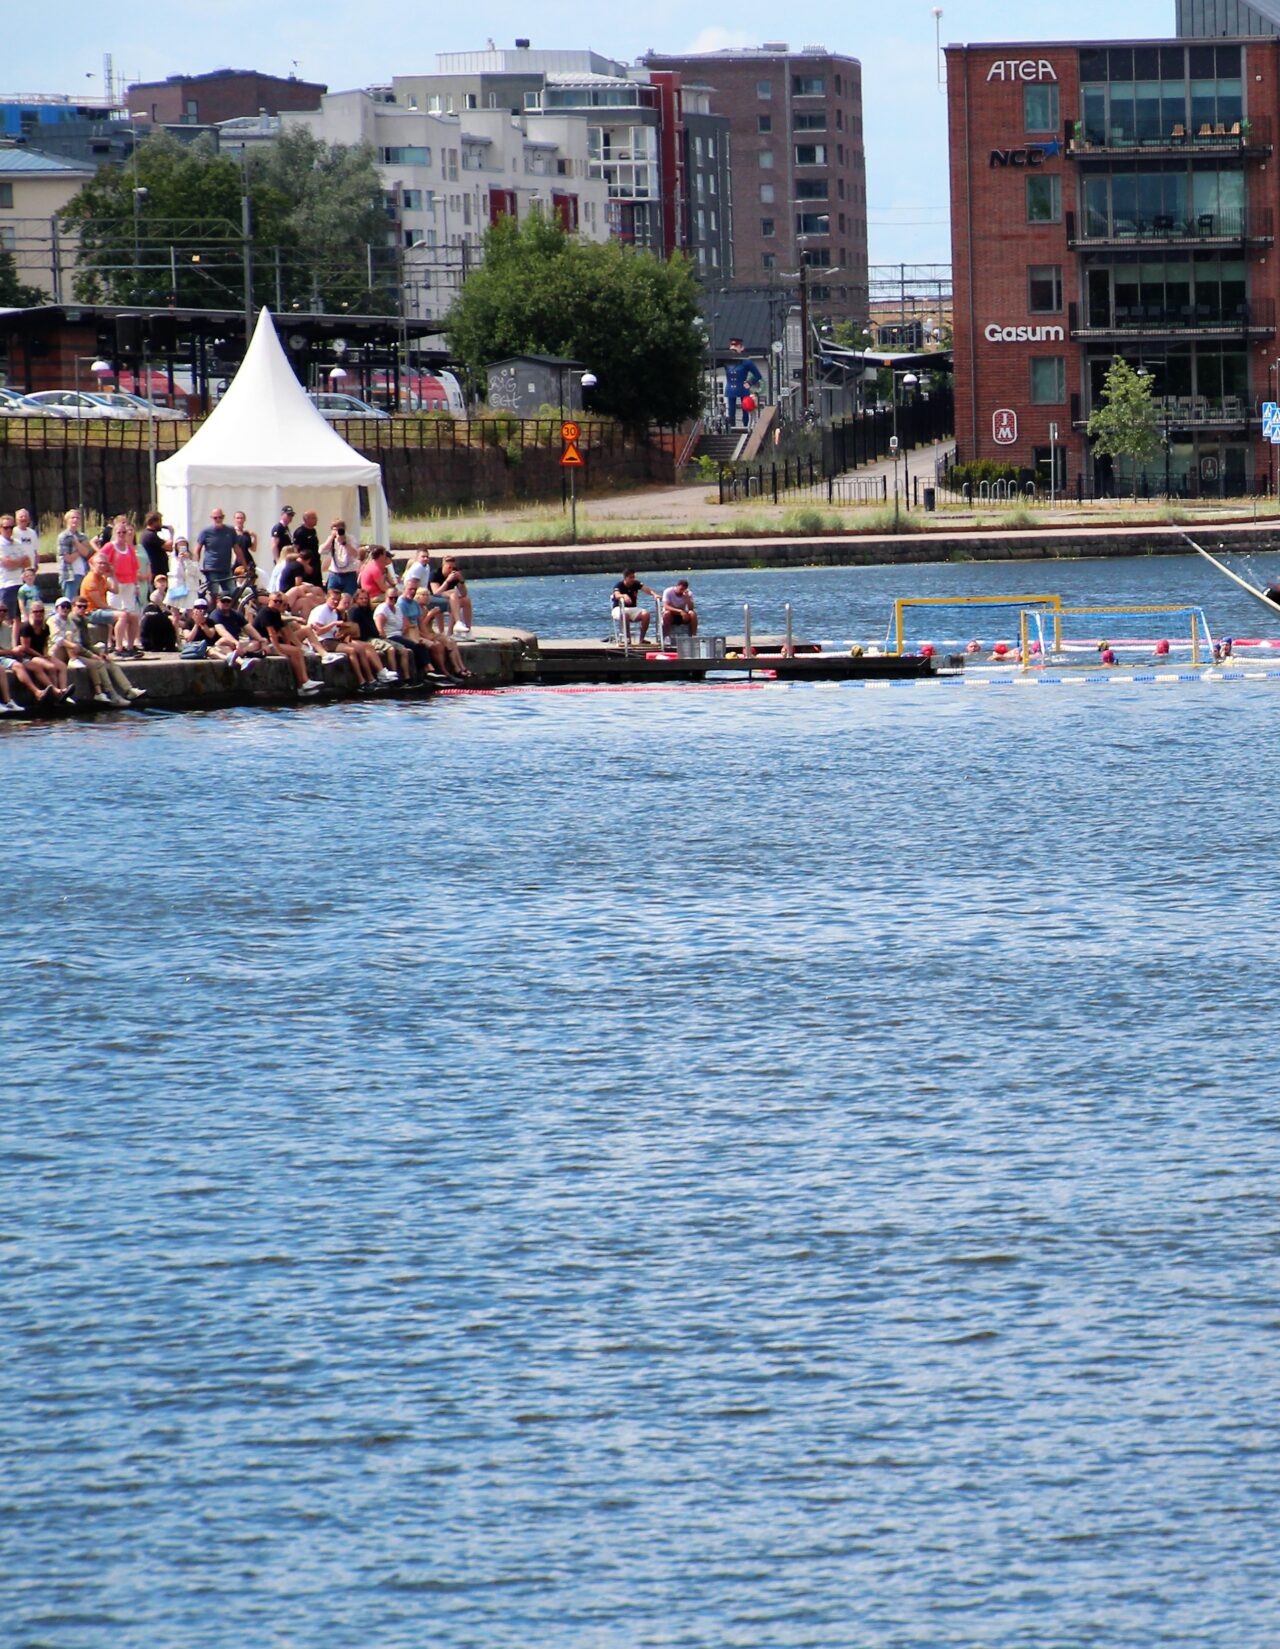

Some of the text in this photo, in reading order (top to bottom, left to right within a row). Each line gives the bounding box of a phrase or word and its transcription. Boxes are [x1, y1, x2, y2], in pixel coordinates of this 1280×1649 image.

[986, 59, 1057, 81] ATEA
[990, 149, 1045, 168] NCC
[984, 323, 1064, 342] Gasum
[564, 427, 576, 437] 30
